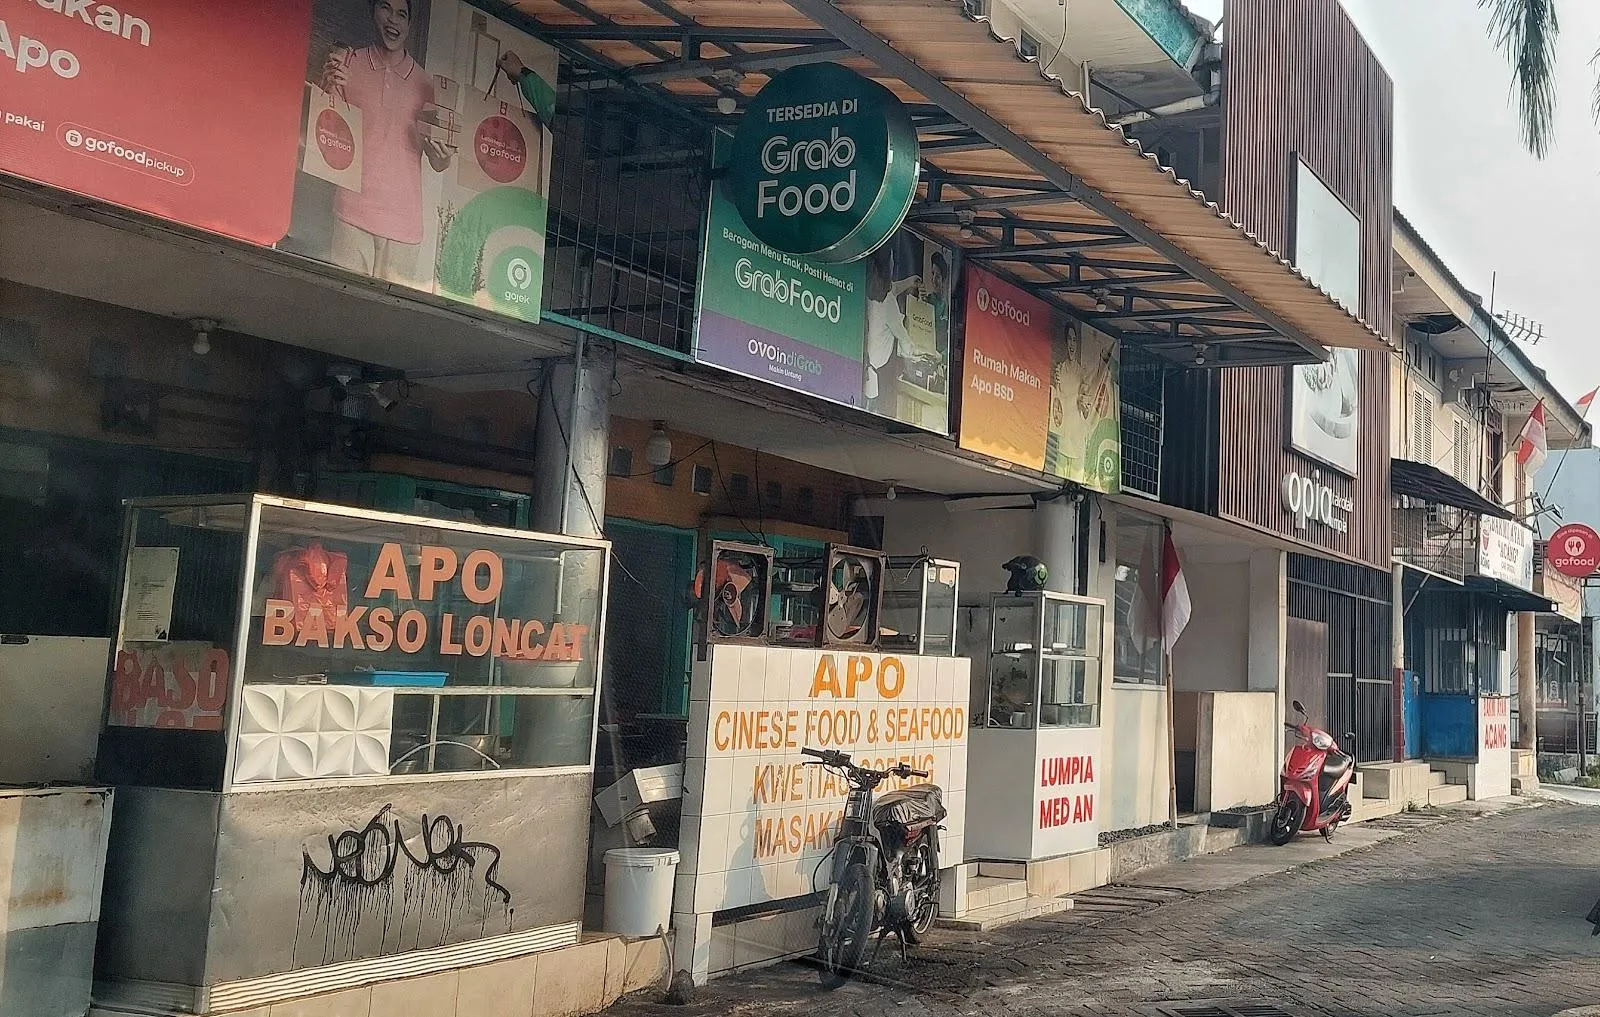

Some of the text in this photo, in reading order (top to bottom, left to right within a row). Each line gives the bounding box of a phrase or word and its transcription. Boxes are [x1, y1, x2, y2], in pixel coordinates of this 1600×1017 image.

[5, 111, 45, 132] pakai
[767, 99, 858, 123] TERSEDIA DI
[489, 147, 521, 163] gofood
[761, 127, 856, 174] Grab
[758, 170, 857, 218] Food
[722, 227, 760, 253] Beragam
[760, 243, 782, 261] Menu
[803, 263, 823, 280] Pasti
[823, 271, 846, 289] Hemat
[846, 281, 854, 292] di
[504, 290, 530, 304] gojek
[734, 258, 842, 324] GrabFood
[990, 297, 1030, 327] gofood
[970, 374, 1015, 402] Apo BSD
[973, 348, 1041, 389] Rumah Makan
[364, 541, 504, 604] APO
[1555, 557, 1595, 567] gofood
[262, 598, 592, 662] BAKSO LONCAT
[110, 648, 230, 714] BASO
[808, 654, 905, 699] APO
[714, 707, 964, 751] CINESE FOOD & SEAFOOD
[1041, 756, 1094, 787] LUMPIA
